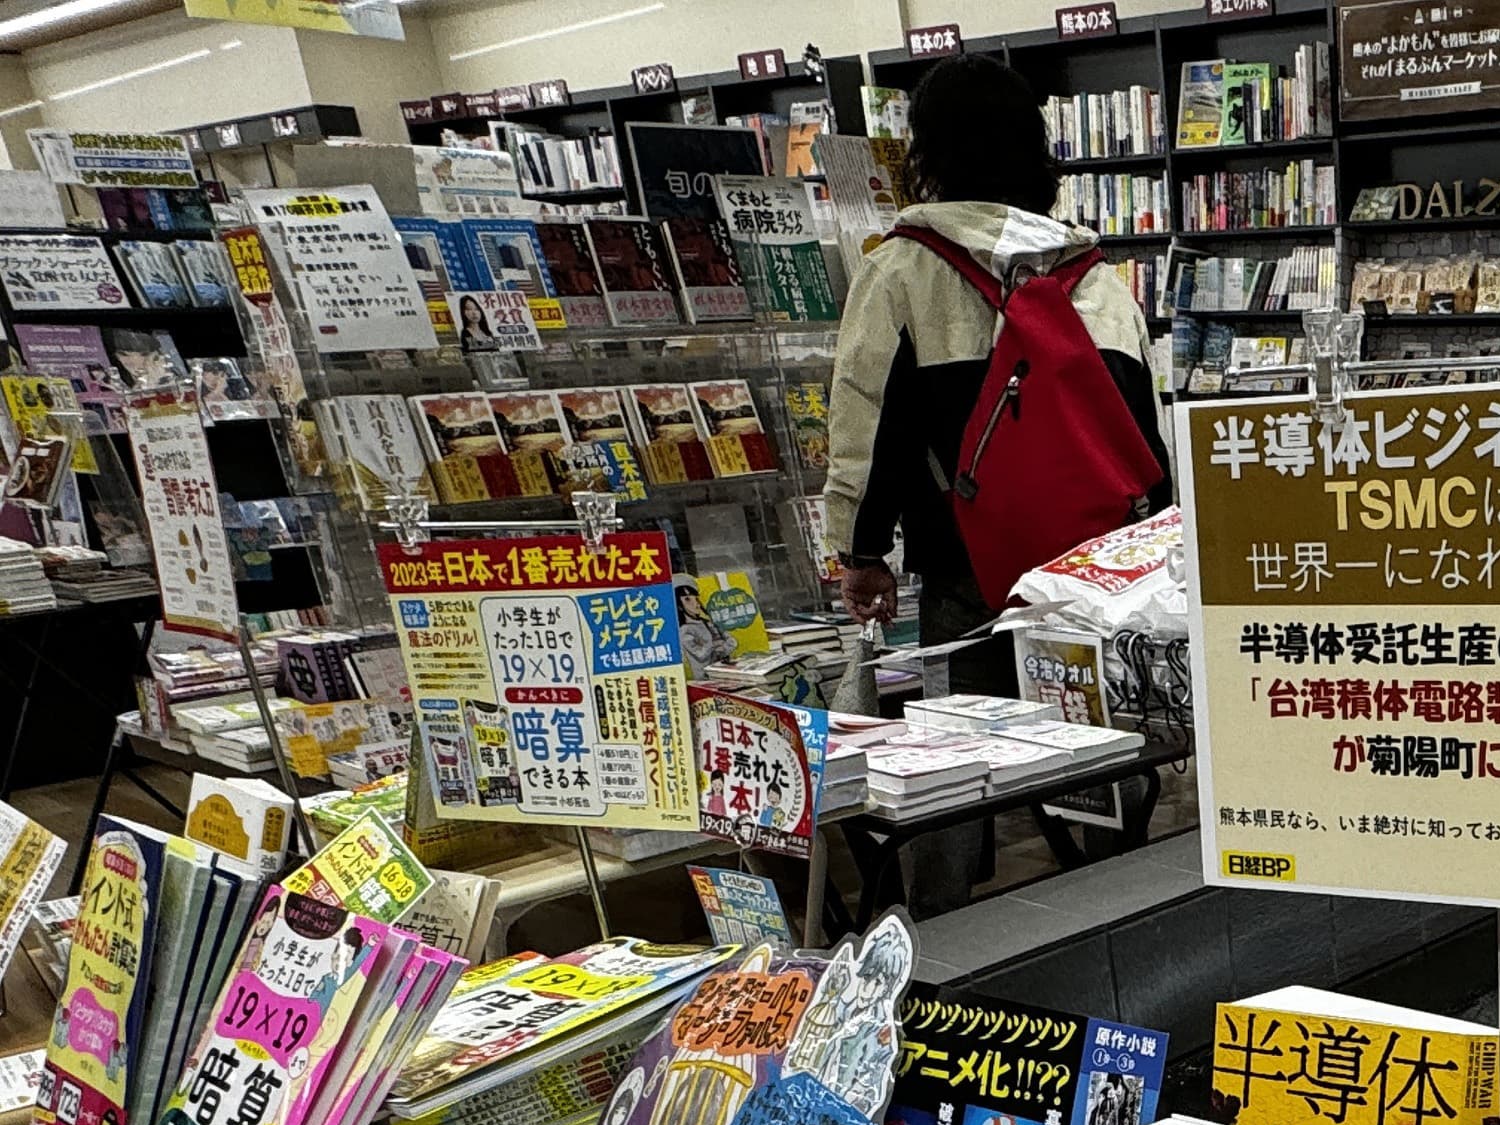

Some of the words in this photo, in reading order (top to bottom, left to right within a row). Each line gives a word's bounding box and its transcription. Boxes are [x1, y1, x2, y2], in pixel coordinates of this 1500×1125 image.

[1060, 10, 1113, 35] 熊本の本
[909, 28, 956, 54] 熊本の本
[725, 189, 773, 209] くまもと
[732, 208, 777, 236] 病院
[390, 542, 664, 588] 2023年日本で1番売れた本
[432, 614, 467, 628] ようになる
[497, 605, 562, 628] 小学生が
[589, 592, 660, 625] テレビや
[493, 625, 576, 651] たった1日で
[598, 617, 666, 650] メディア
[511, 707, 592, 765] 暗算
[718, 718, 768, 754] 日本で
[522, 763, 593, 794] できる本
[702, 745, 791, 789] 1番売れた
[1226, 854, 1291, 879] 日経BP
[272, 936, 323, 969] 小学生が
[256, 959, 317, 997] たった1日で
[1095, 1026, 1158, 1058] 原作小説
